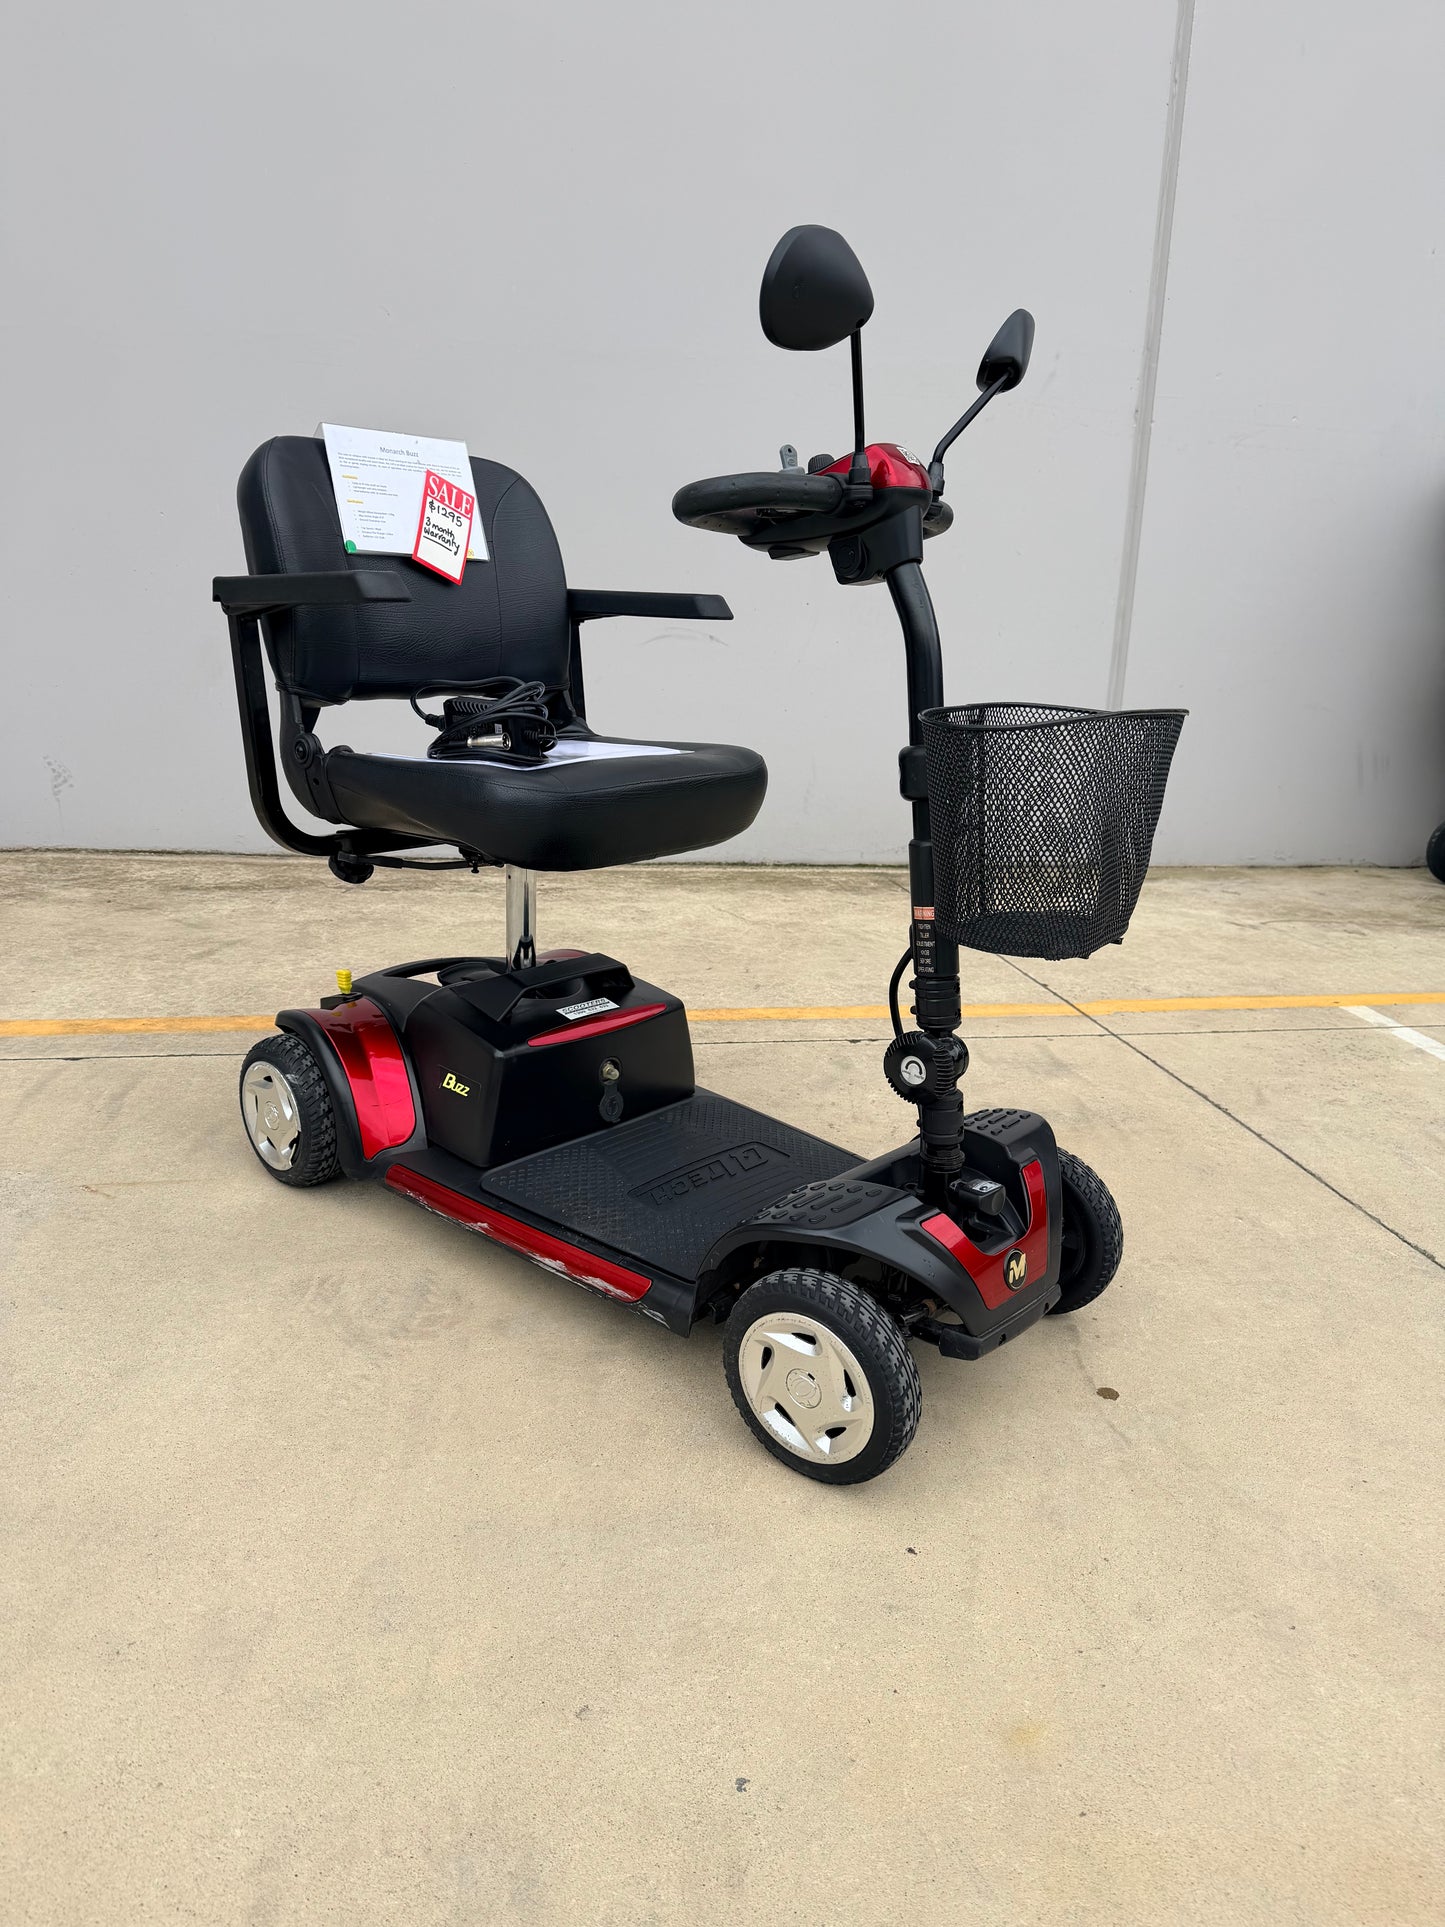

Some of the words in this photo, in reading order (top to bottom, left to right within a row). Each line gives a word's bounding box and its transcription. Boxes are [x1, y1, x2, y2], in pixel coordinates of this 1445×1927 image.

[379, 446, 406, 457] Monarch
[405, 449, 419, 458] Buzz
[427, 475, 472, 518] SALE
[428, 499, 463, 528] $1295
[425, 516, 432, 527] 3
[431, 523, 456, 541] month
[423, 526, 460, 557] warranty
[562, 997, 606, 1013] SCOOTERS
[442, 1072, 470, 1097] Buzz
